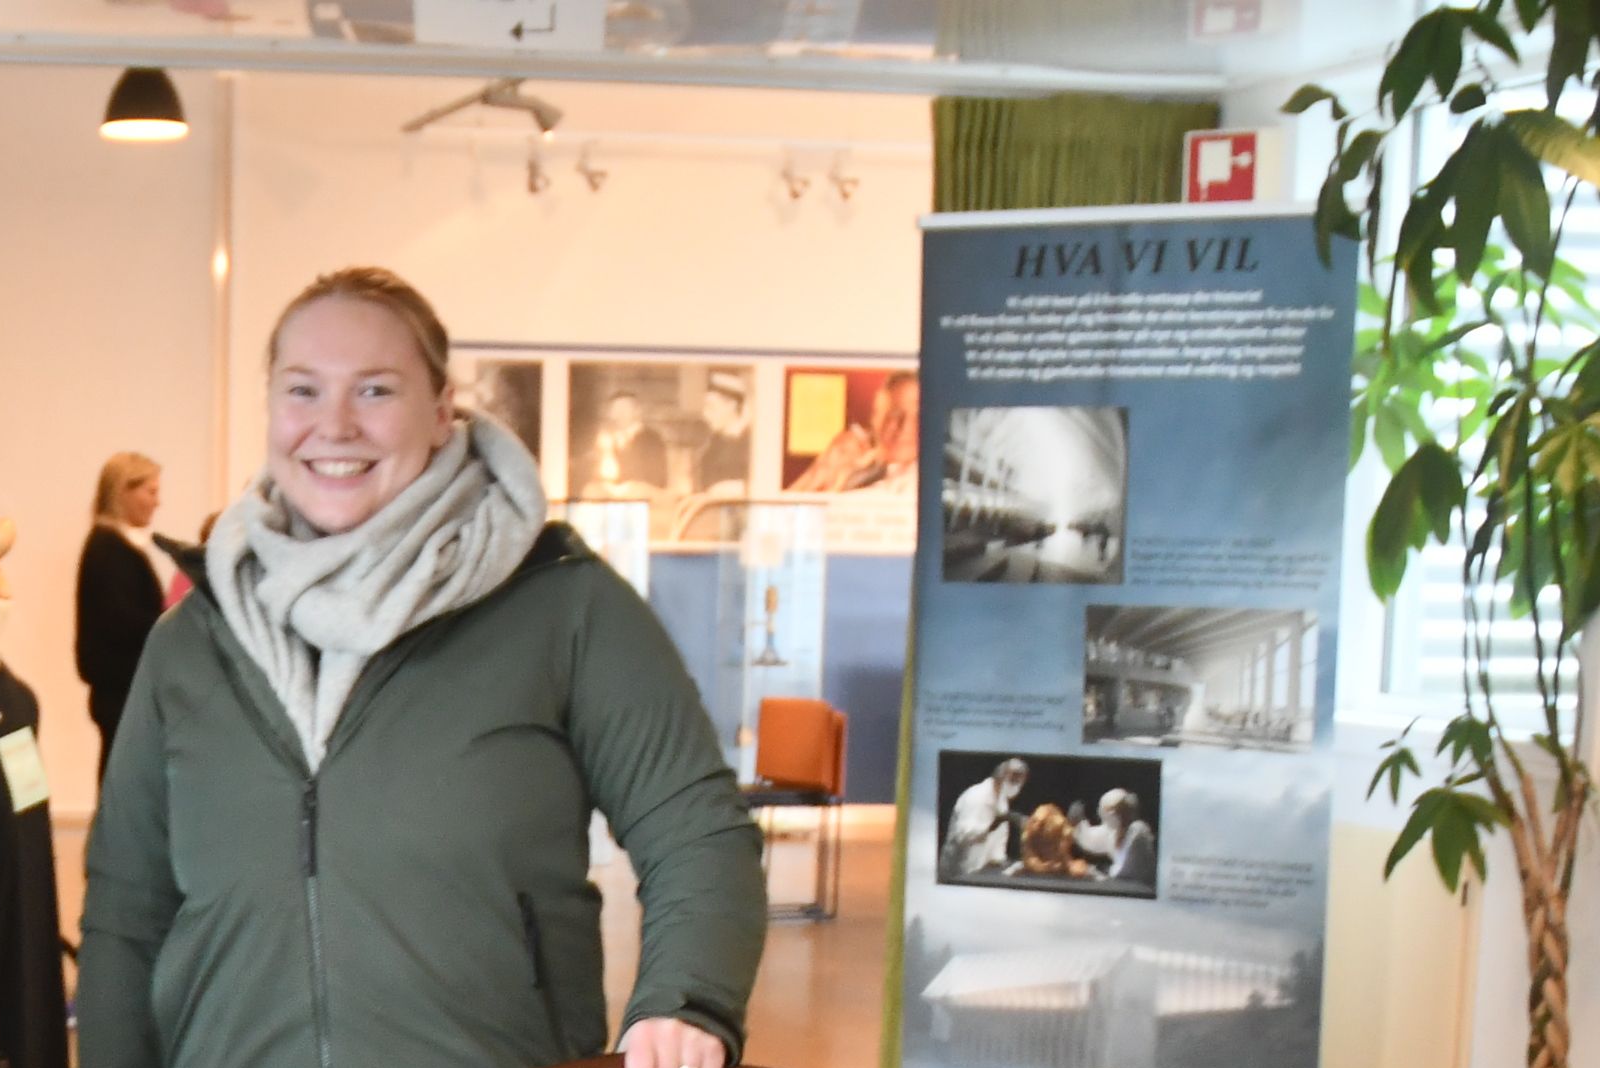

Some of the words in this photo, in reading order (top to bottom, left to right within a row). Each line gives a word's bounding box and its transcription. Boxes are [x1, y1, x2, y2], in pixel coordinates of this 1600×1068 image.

[1013, 242, 1102, 278] HVA
[1122, 239, 1168, 273] VI
[1186, 237, 1259, 272] VIL
